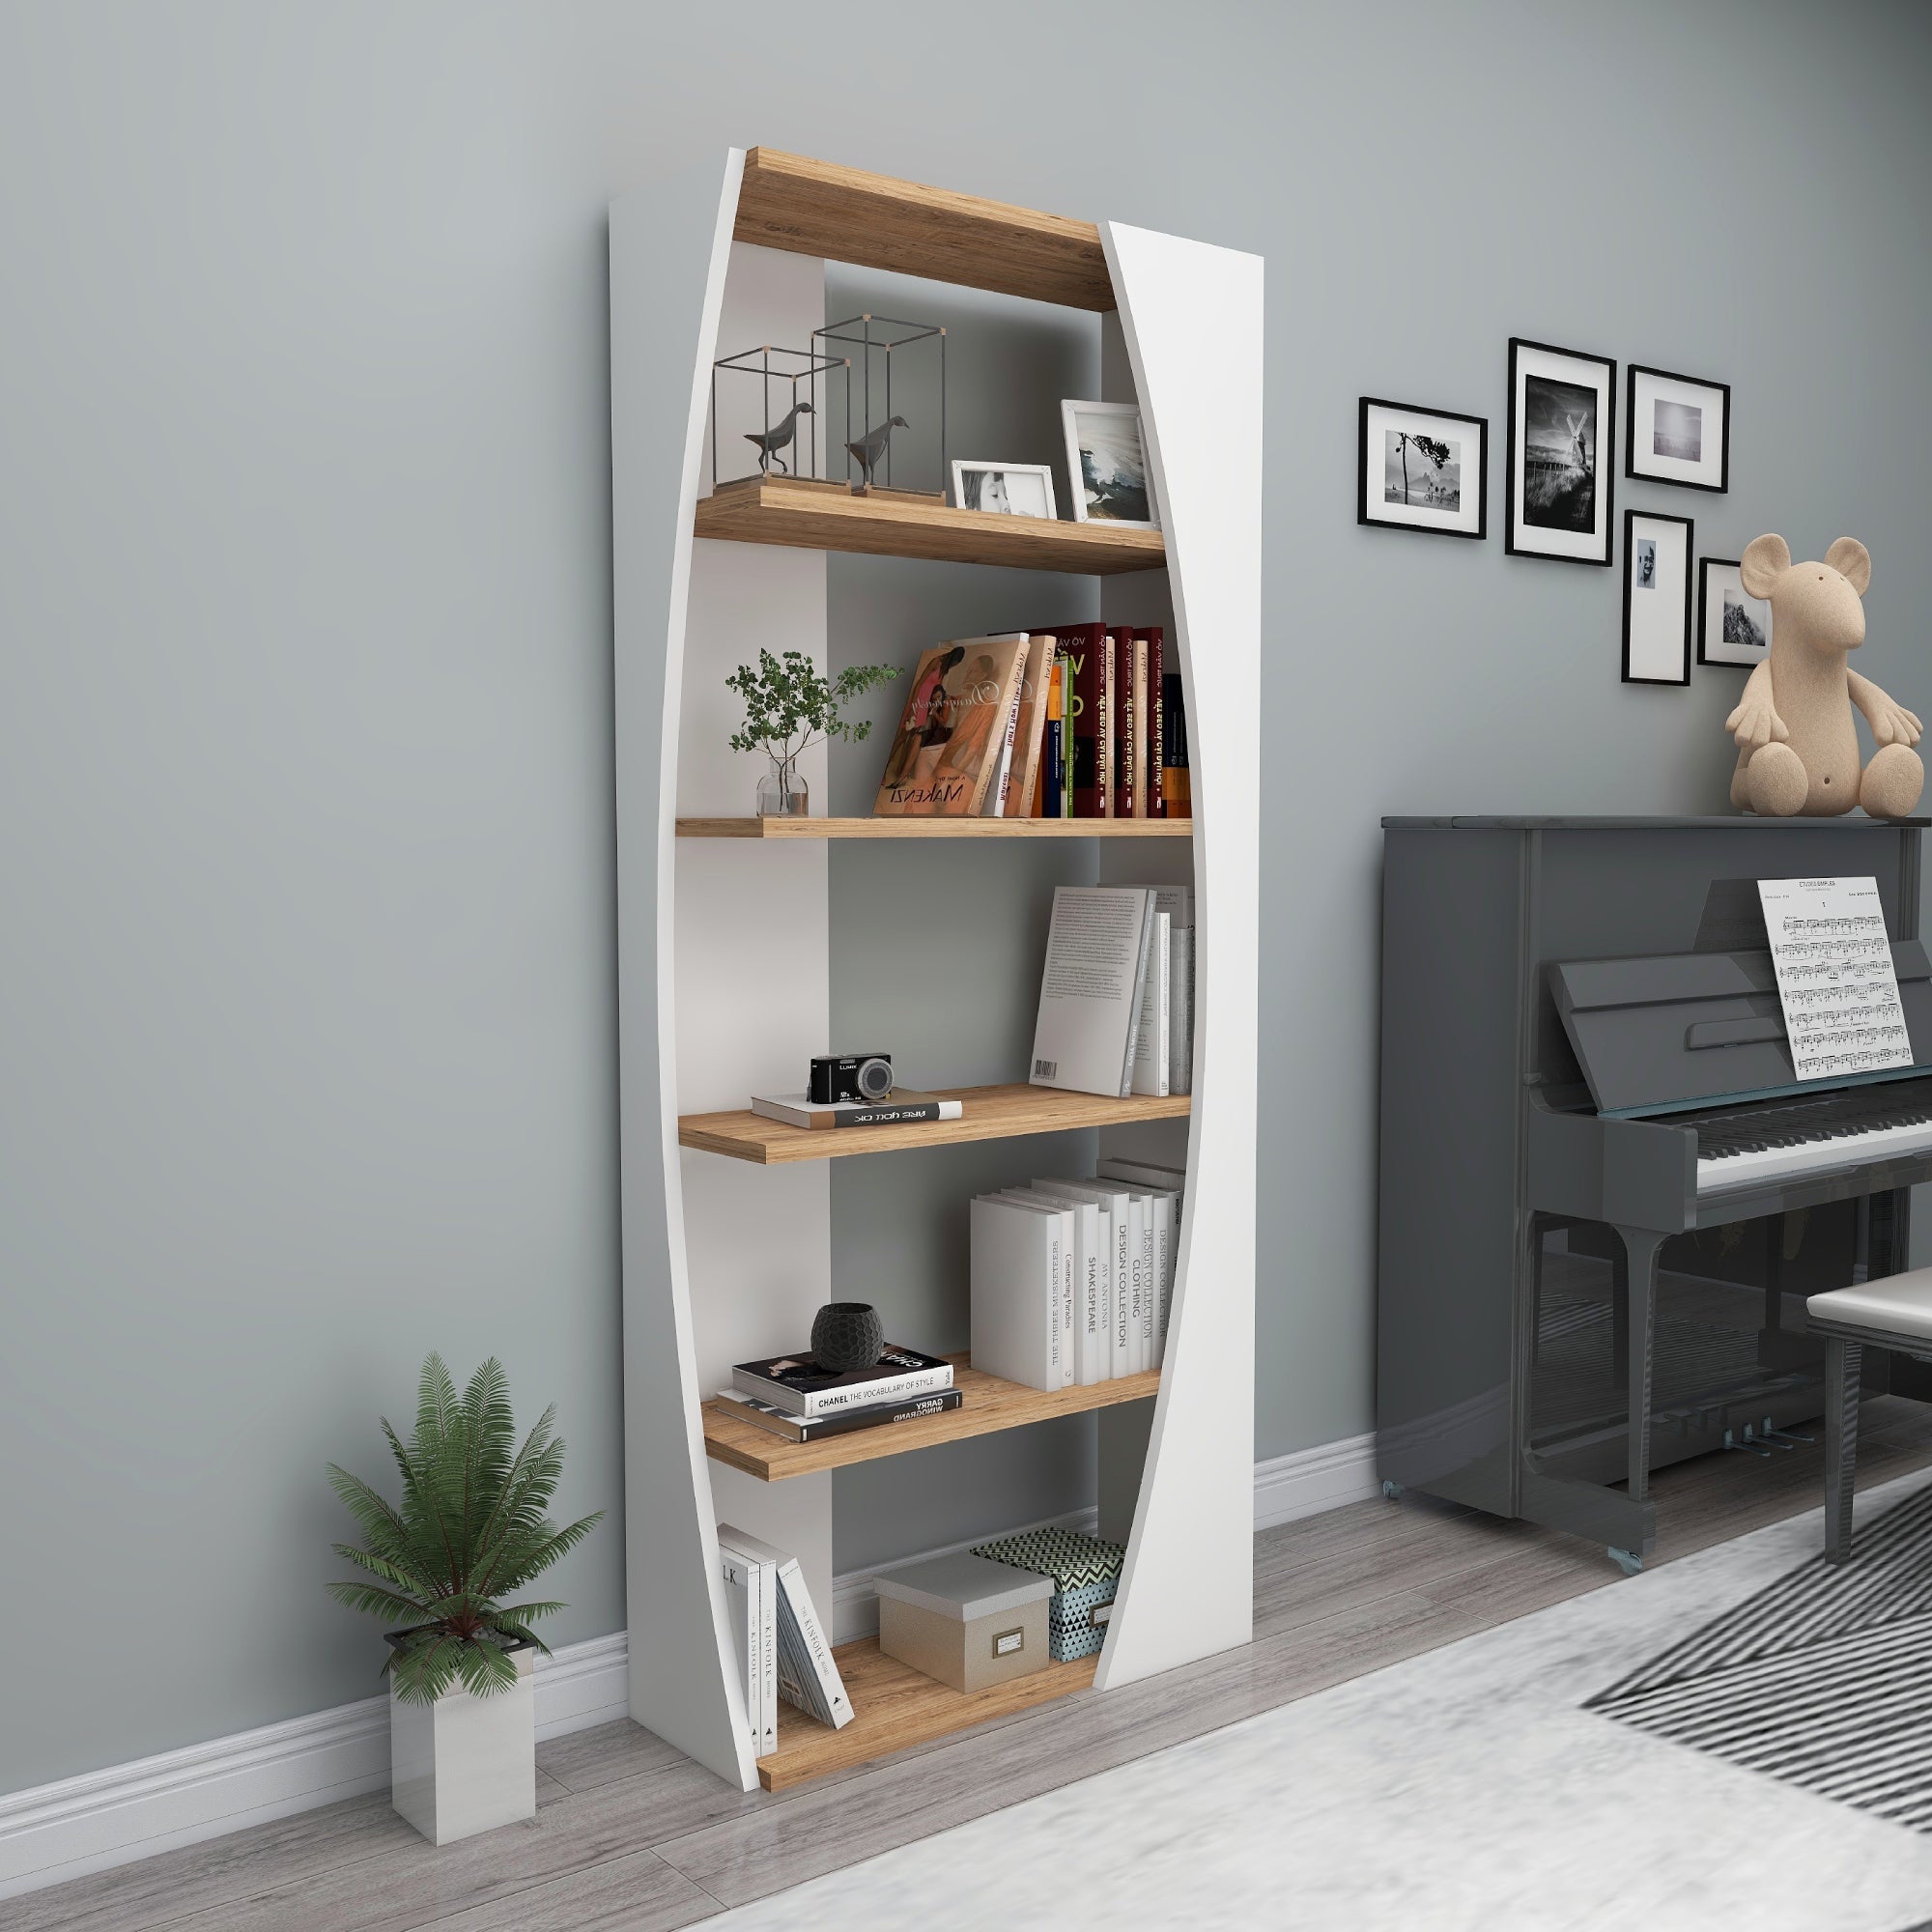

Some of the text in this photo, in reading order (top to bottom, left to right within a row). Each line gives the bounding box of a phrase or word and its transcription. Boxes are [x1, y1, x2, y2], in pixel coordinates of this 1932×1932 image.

[1088, 1257, 1096, 1334] SHAKESPEARE
[819, 1395, 848, 1408] CHANEL
[850, 1393, 862, 1402] THE
[864, 1384, 905, 1399] VOCABULARY
[906, 1381, 915, 1390] OF
[916, 1378, 934, 1387] STYLE
[804, 1619, 825, 1660] KINFOLK
